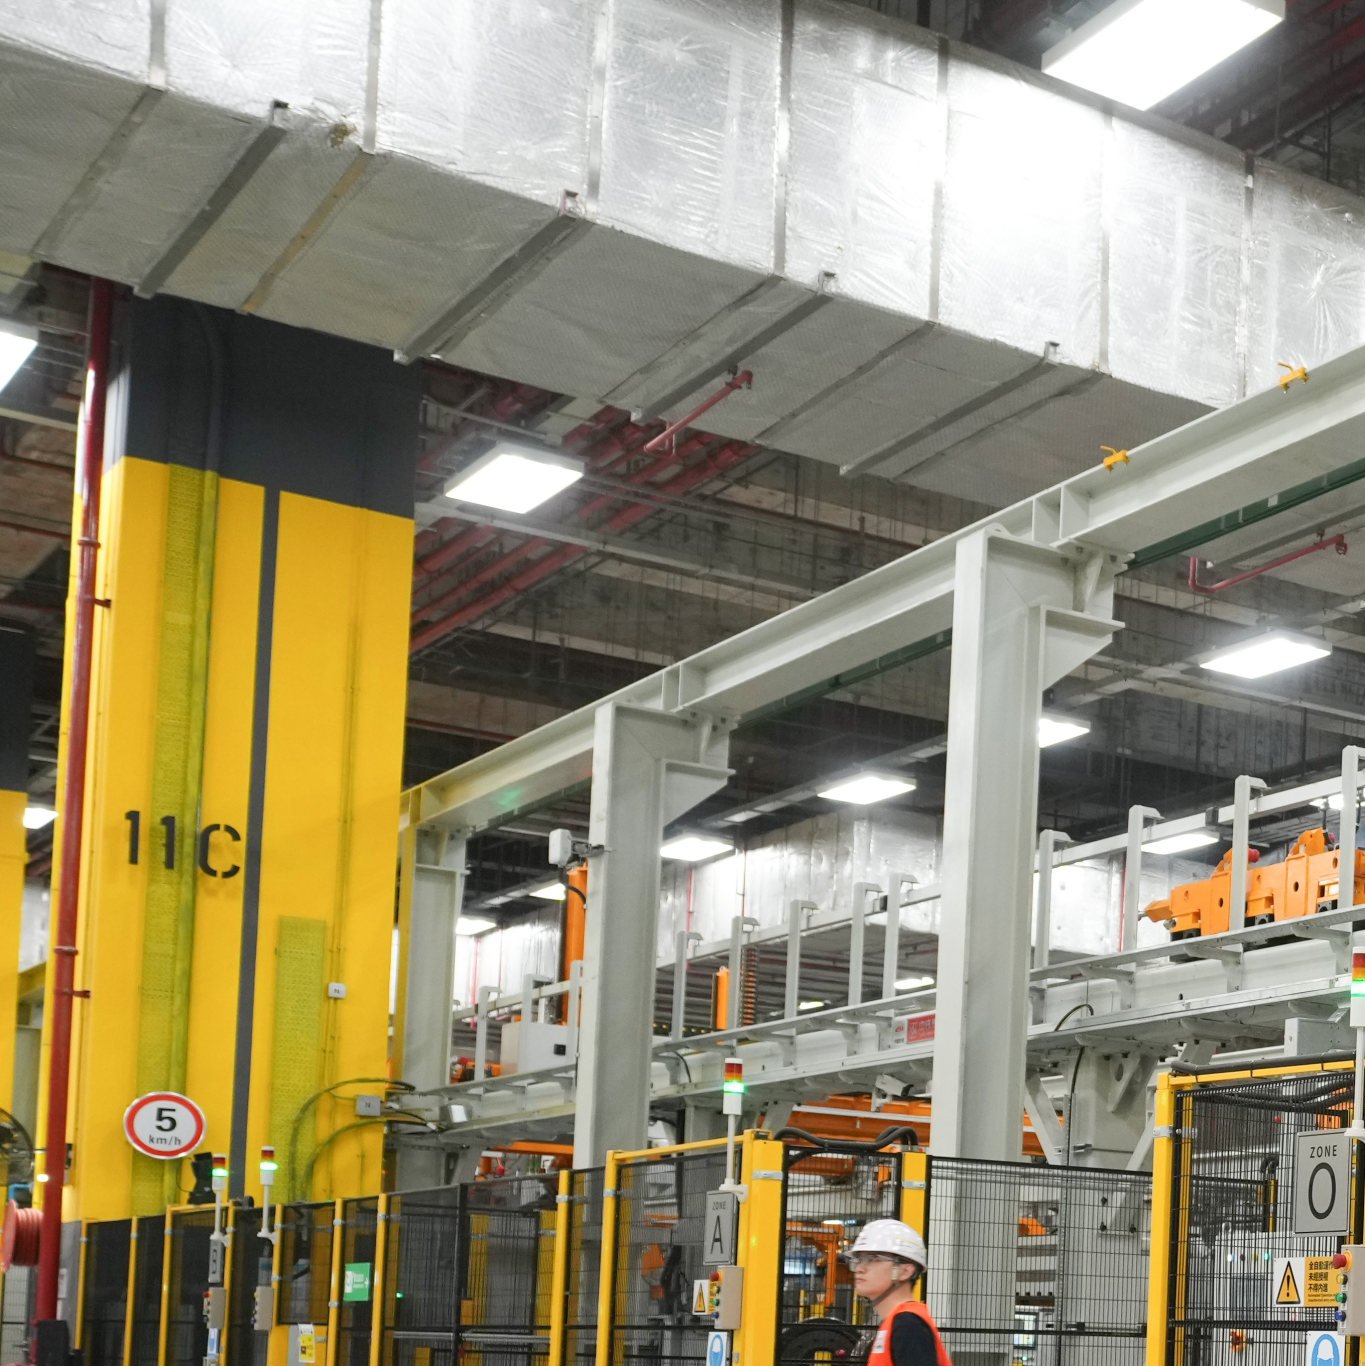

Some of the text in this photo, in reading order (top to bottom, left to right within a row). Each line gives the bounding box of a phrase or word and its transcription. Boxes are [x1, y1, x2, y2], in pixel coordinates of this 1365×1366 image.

[155, 1107, 177, 1132] 5
[149, 1134, 181, 1146] km/h
[1310, 1144, 1338, 1159] ZONE
[712, 1200, 726, 1211] ZONE
[710, 1215, 724, 1254] A
